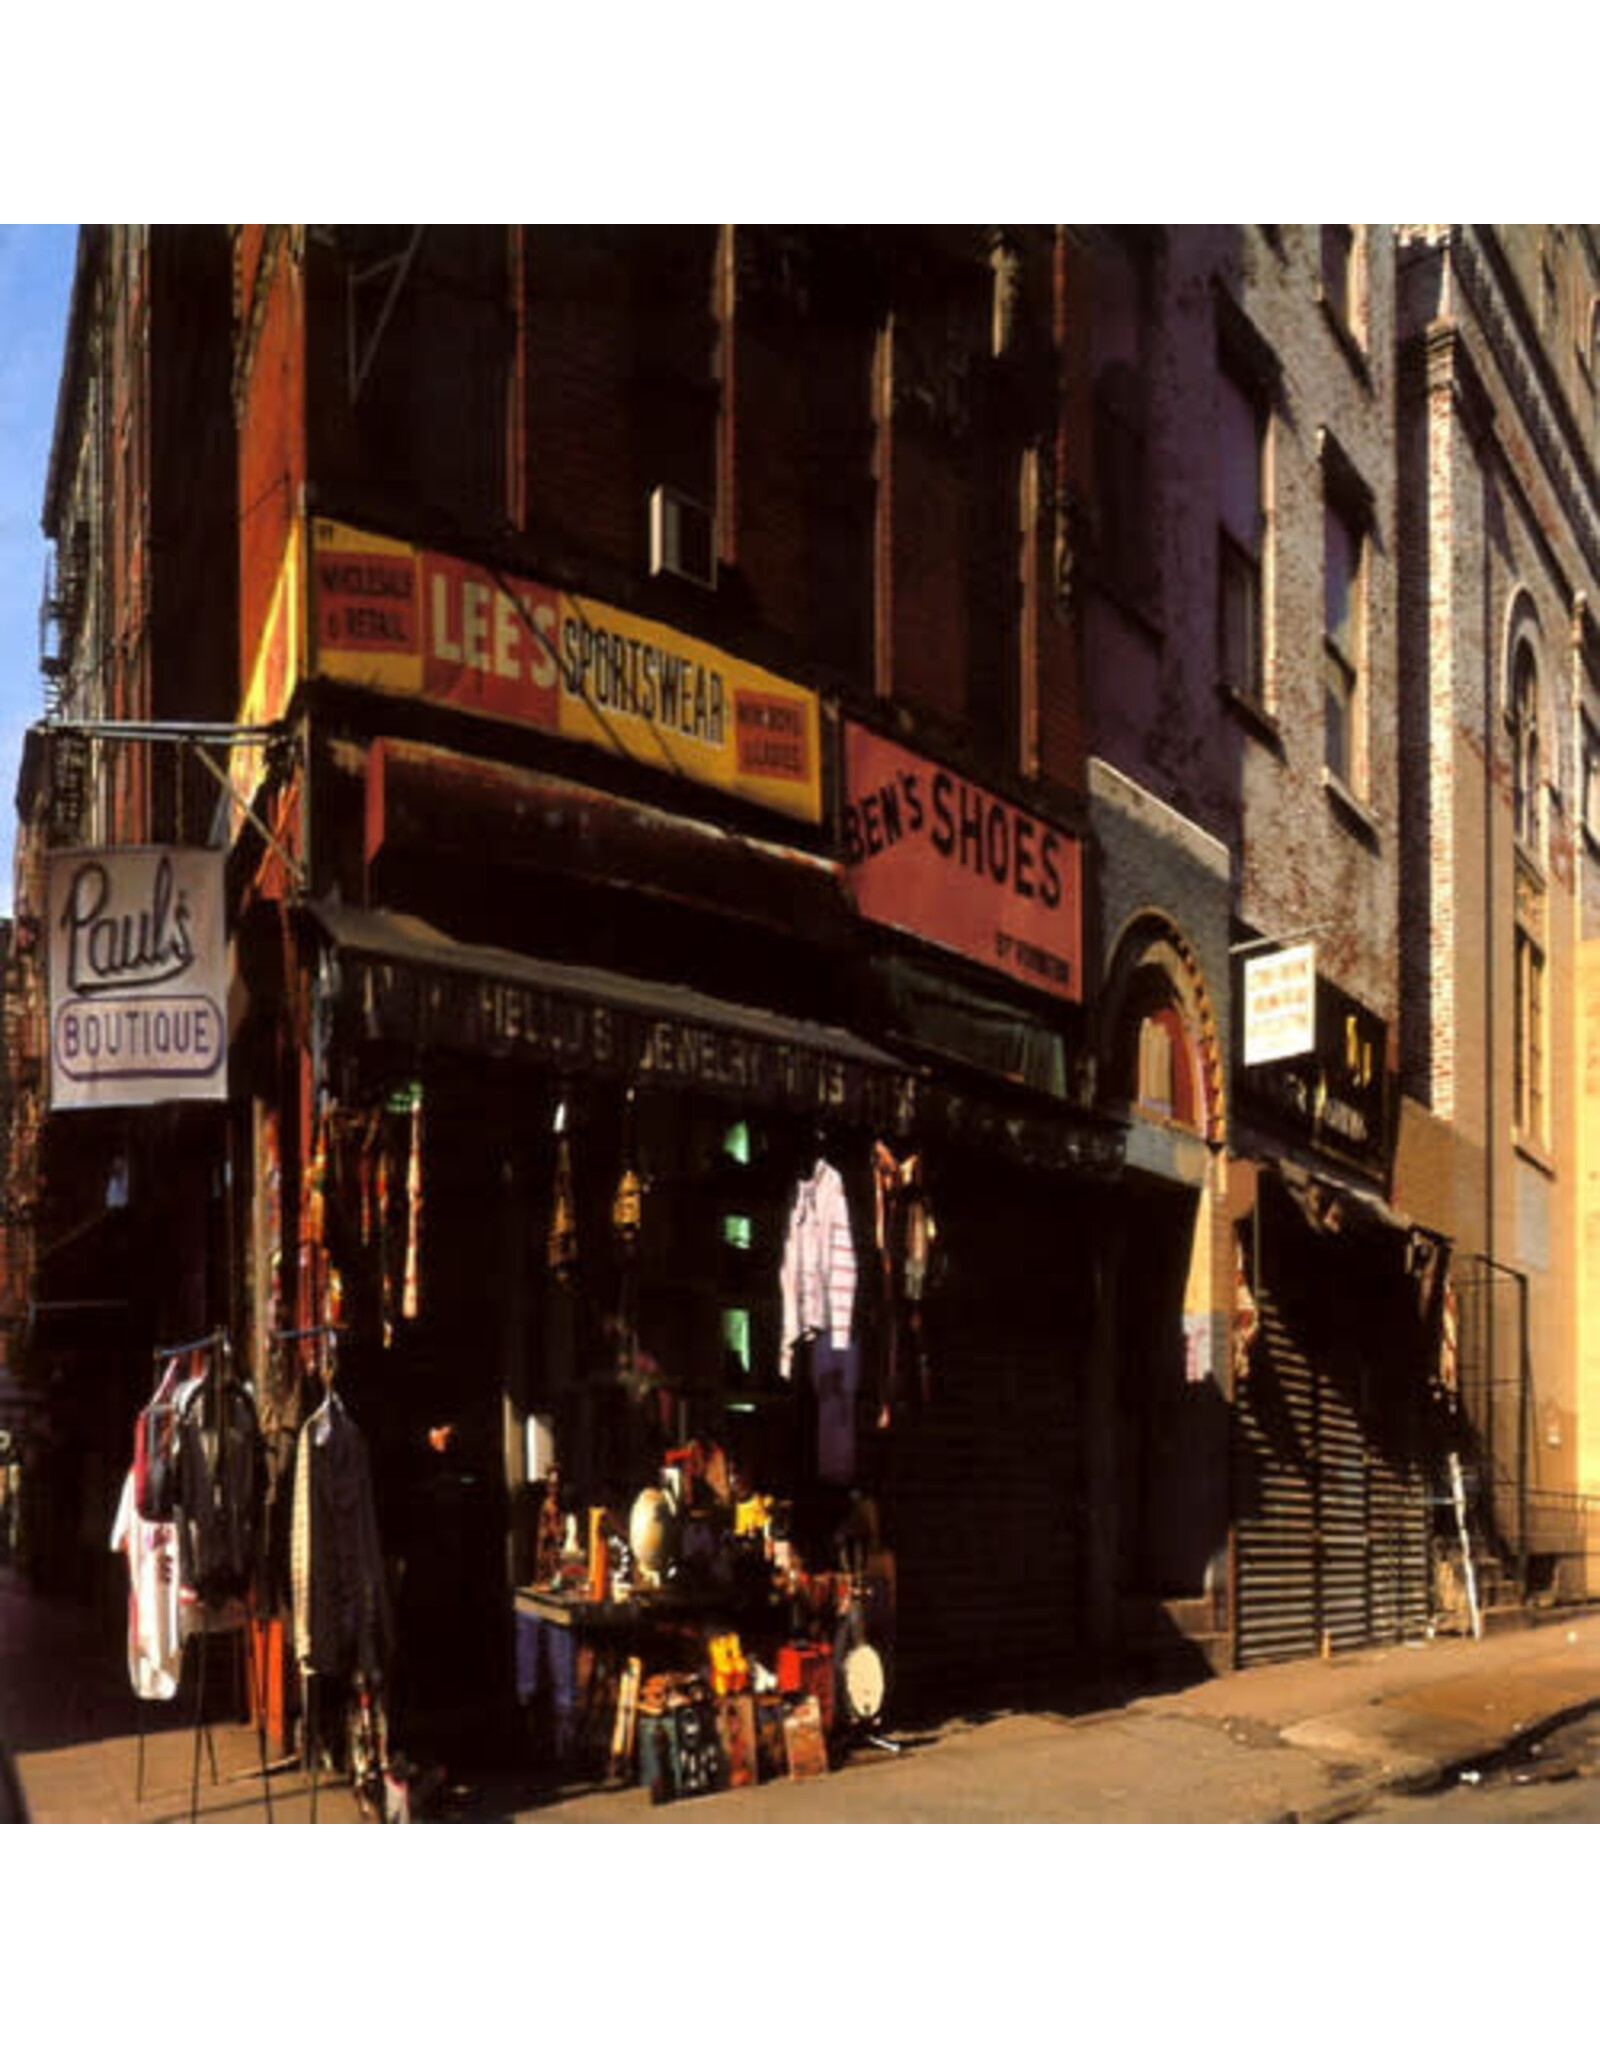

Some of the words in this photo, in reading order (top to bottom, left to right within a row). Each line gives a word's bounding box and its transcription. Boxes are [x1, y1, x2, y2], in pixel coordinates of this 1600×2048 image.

[431, 573, 559, 689] LEE'S
[562, 616, 726, 749] SPORTSWEAR
[844, 770, 924, 866] BEN'S
[930, 771, 1062, 910] SHOES
[60, 855, 195, 997] Paul's
[64, 1010, 211, 1058] BOUTIQUE
